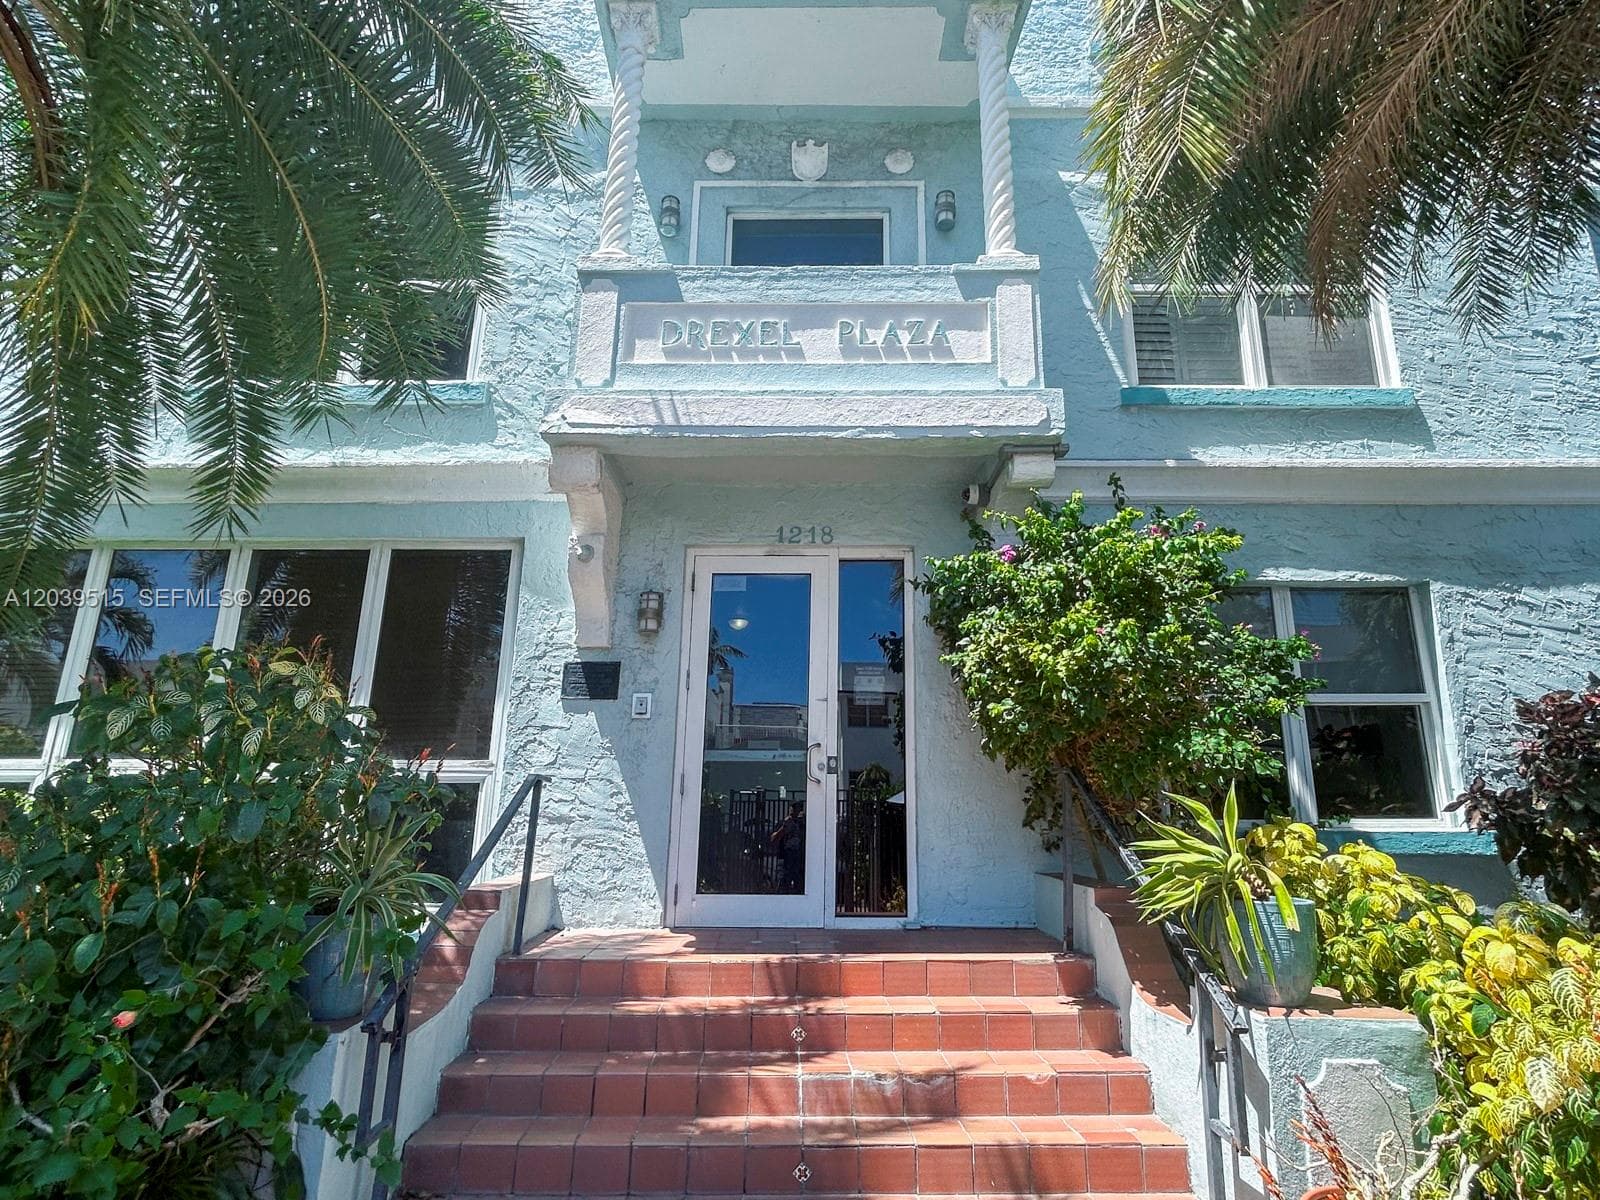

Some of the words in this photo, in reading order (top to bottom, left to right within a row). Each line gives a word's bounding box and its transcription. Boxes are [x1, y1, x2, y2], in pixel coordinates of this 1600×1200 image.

[661, 319, 801, 349] DREXEL
[837, 318, 951, 347] PLAZA
[776, 525, 834, 544] 1218
